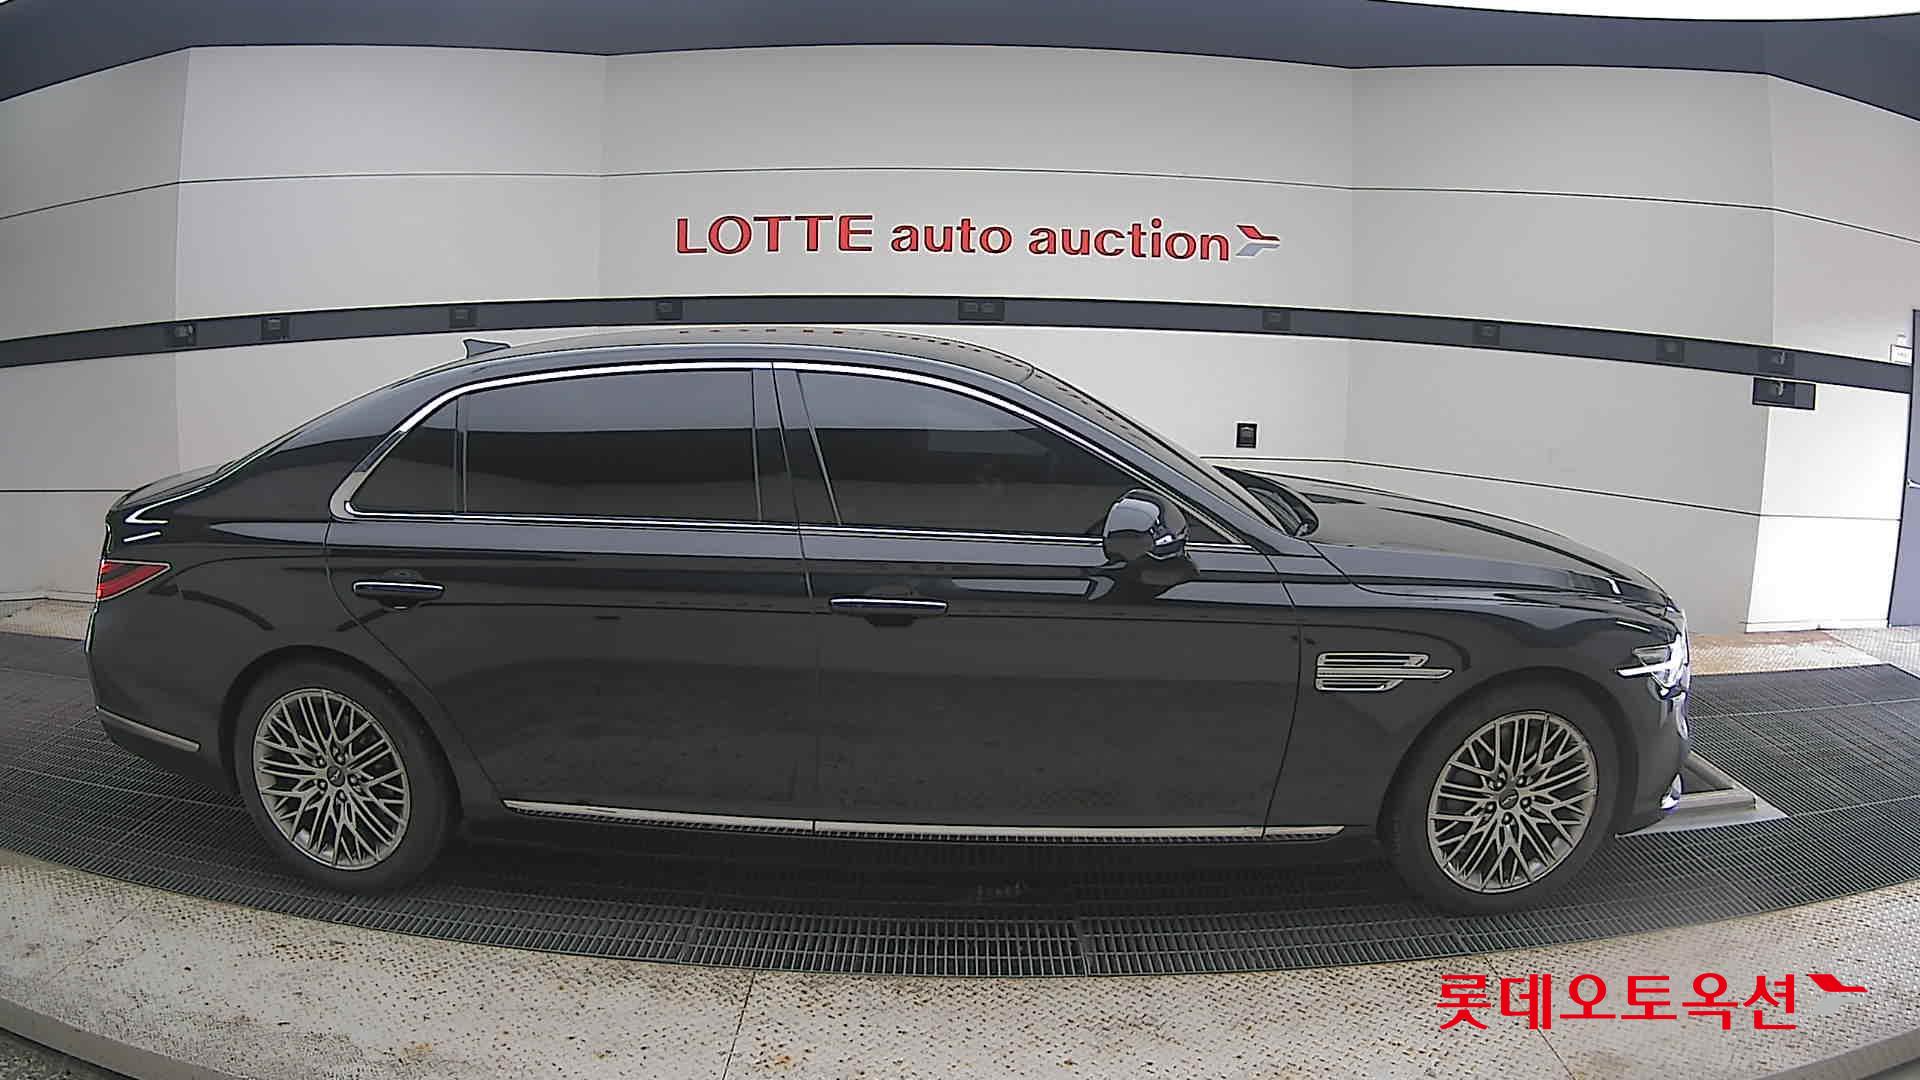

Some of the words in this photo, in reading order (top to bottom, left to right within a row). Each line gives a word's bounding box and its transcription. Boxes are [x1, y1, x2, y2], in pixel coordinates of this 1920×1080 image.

[676, 214, 873, 254] LOTTE
[890, 218, 1012, 254] auto
[1028, 218, 1230, 262] auction
